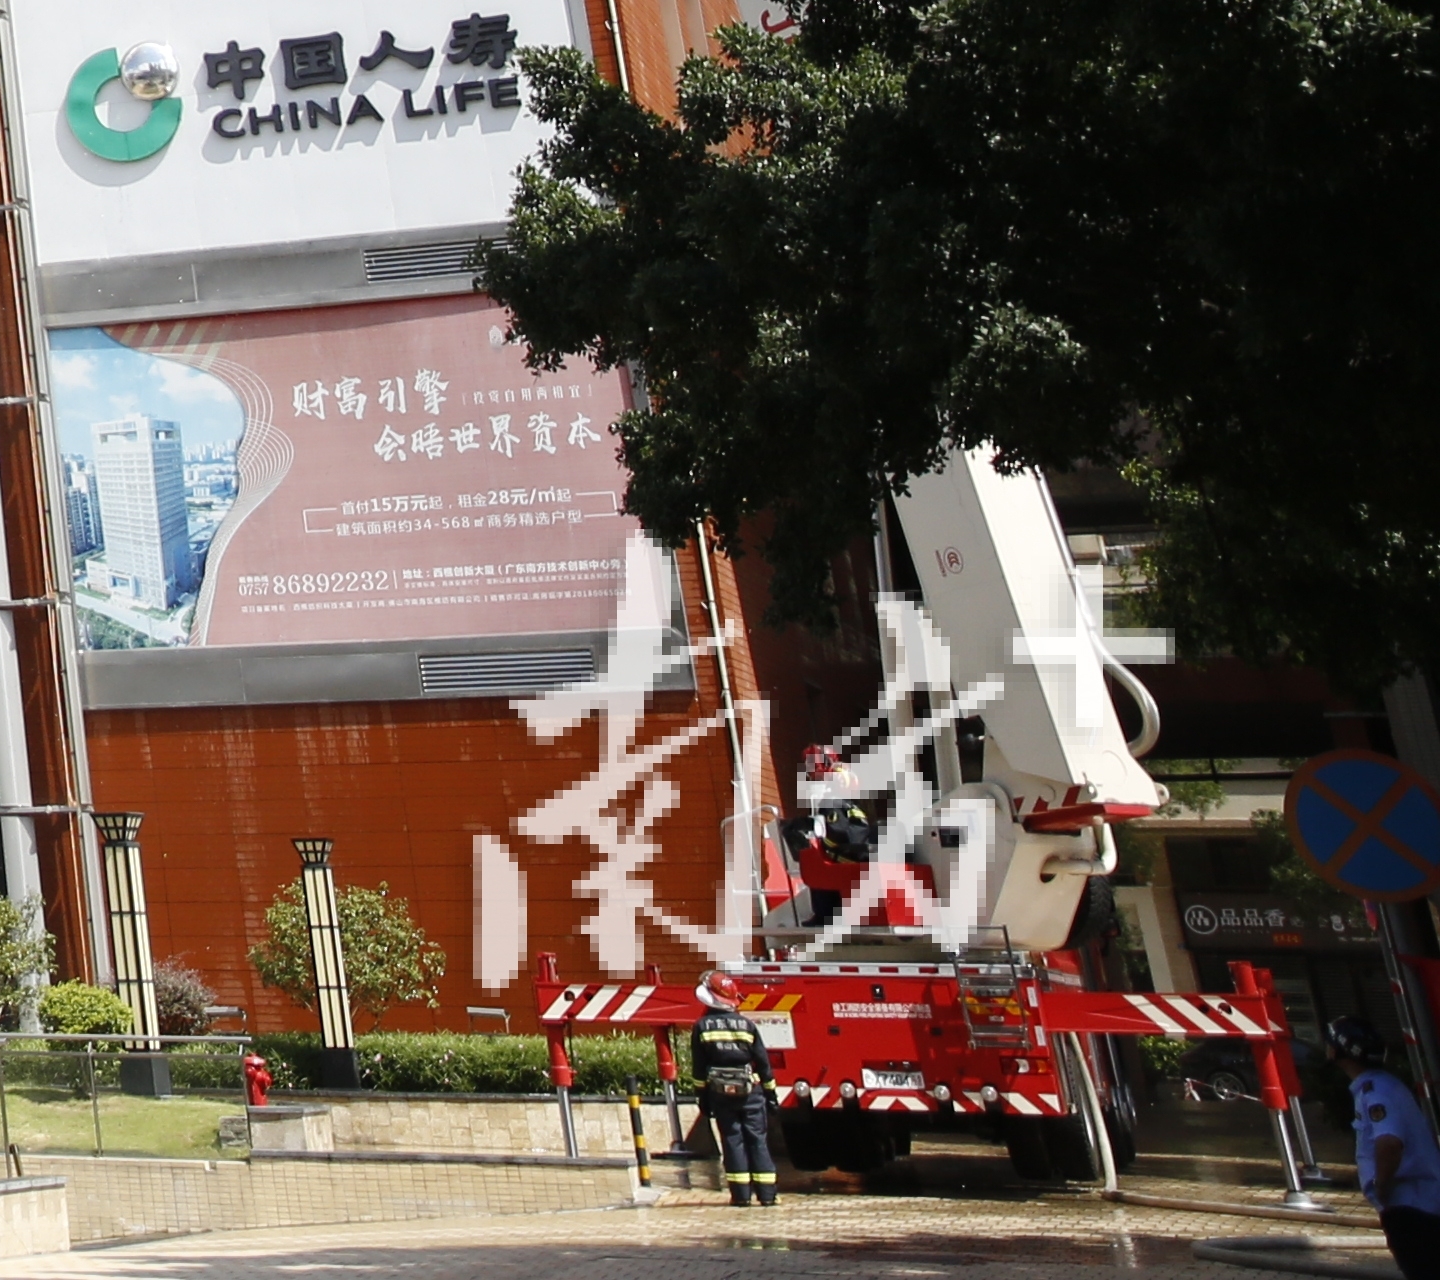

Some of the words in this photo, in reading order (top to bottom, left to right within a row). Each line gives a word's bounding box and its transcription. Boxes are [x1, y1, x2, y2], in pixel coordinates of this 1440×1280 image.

[204, 12, 518, 100] 中国人寿
[213, 94, 384, 138] CHINA
[402, 76, 522, 118] LIFE
[292, 368, 450, 421] 财富引擎
[374, 411, 602, 462] 会晤世界资本
[238, 582, 270, 596] 0757
[272, 569, 390, 595] 86892232
[1220, 908, 1285, 928] 品品香
